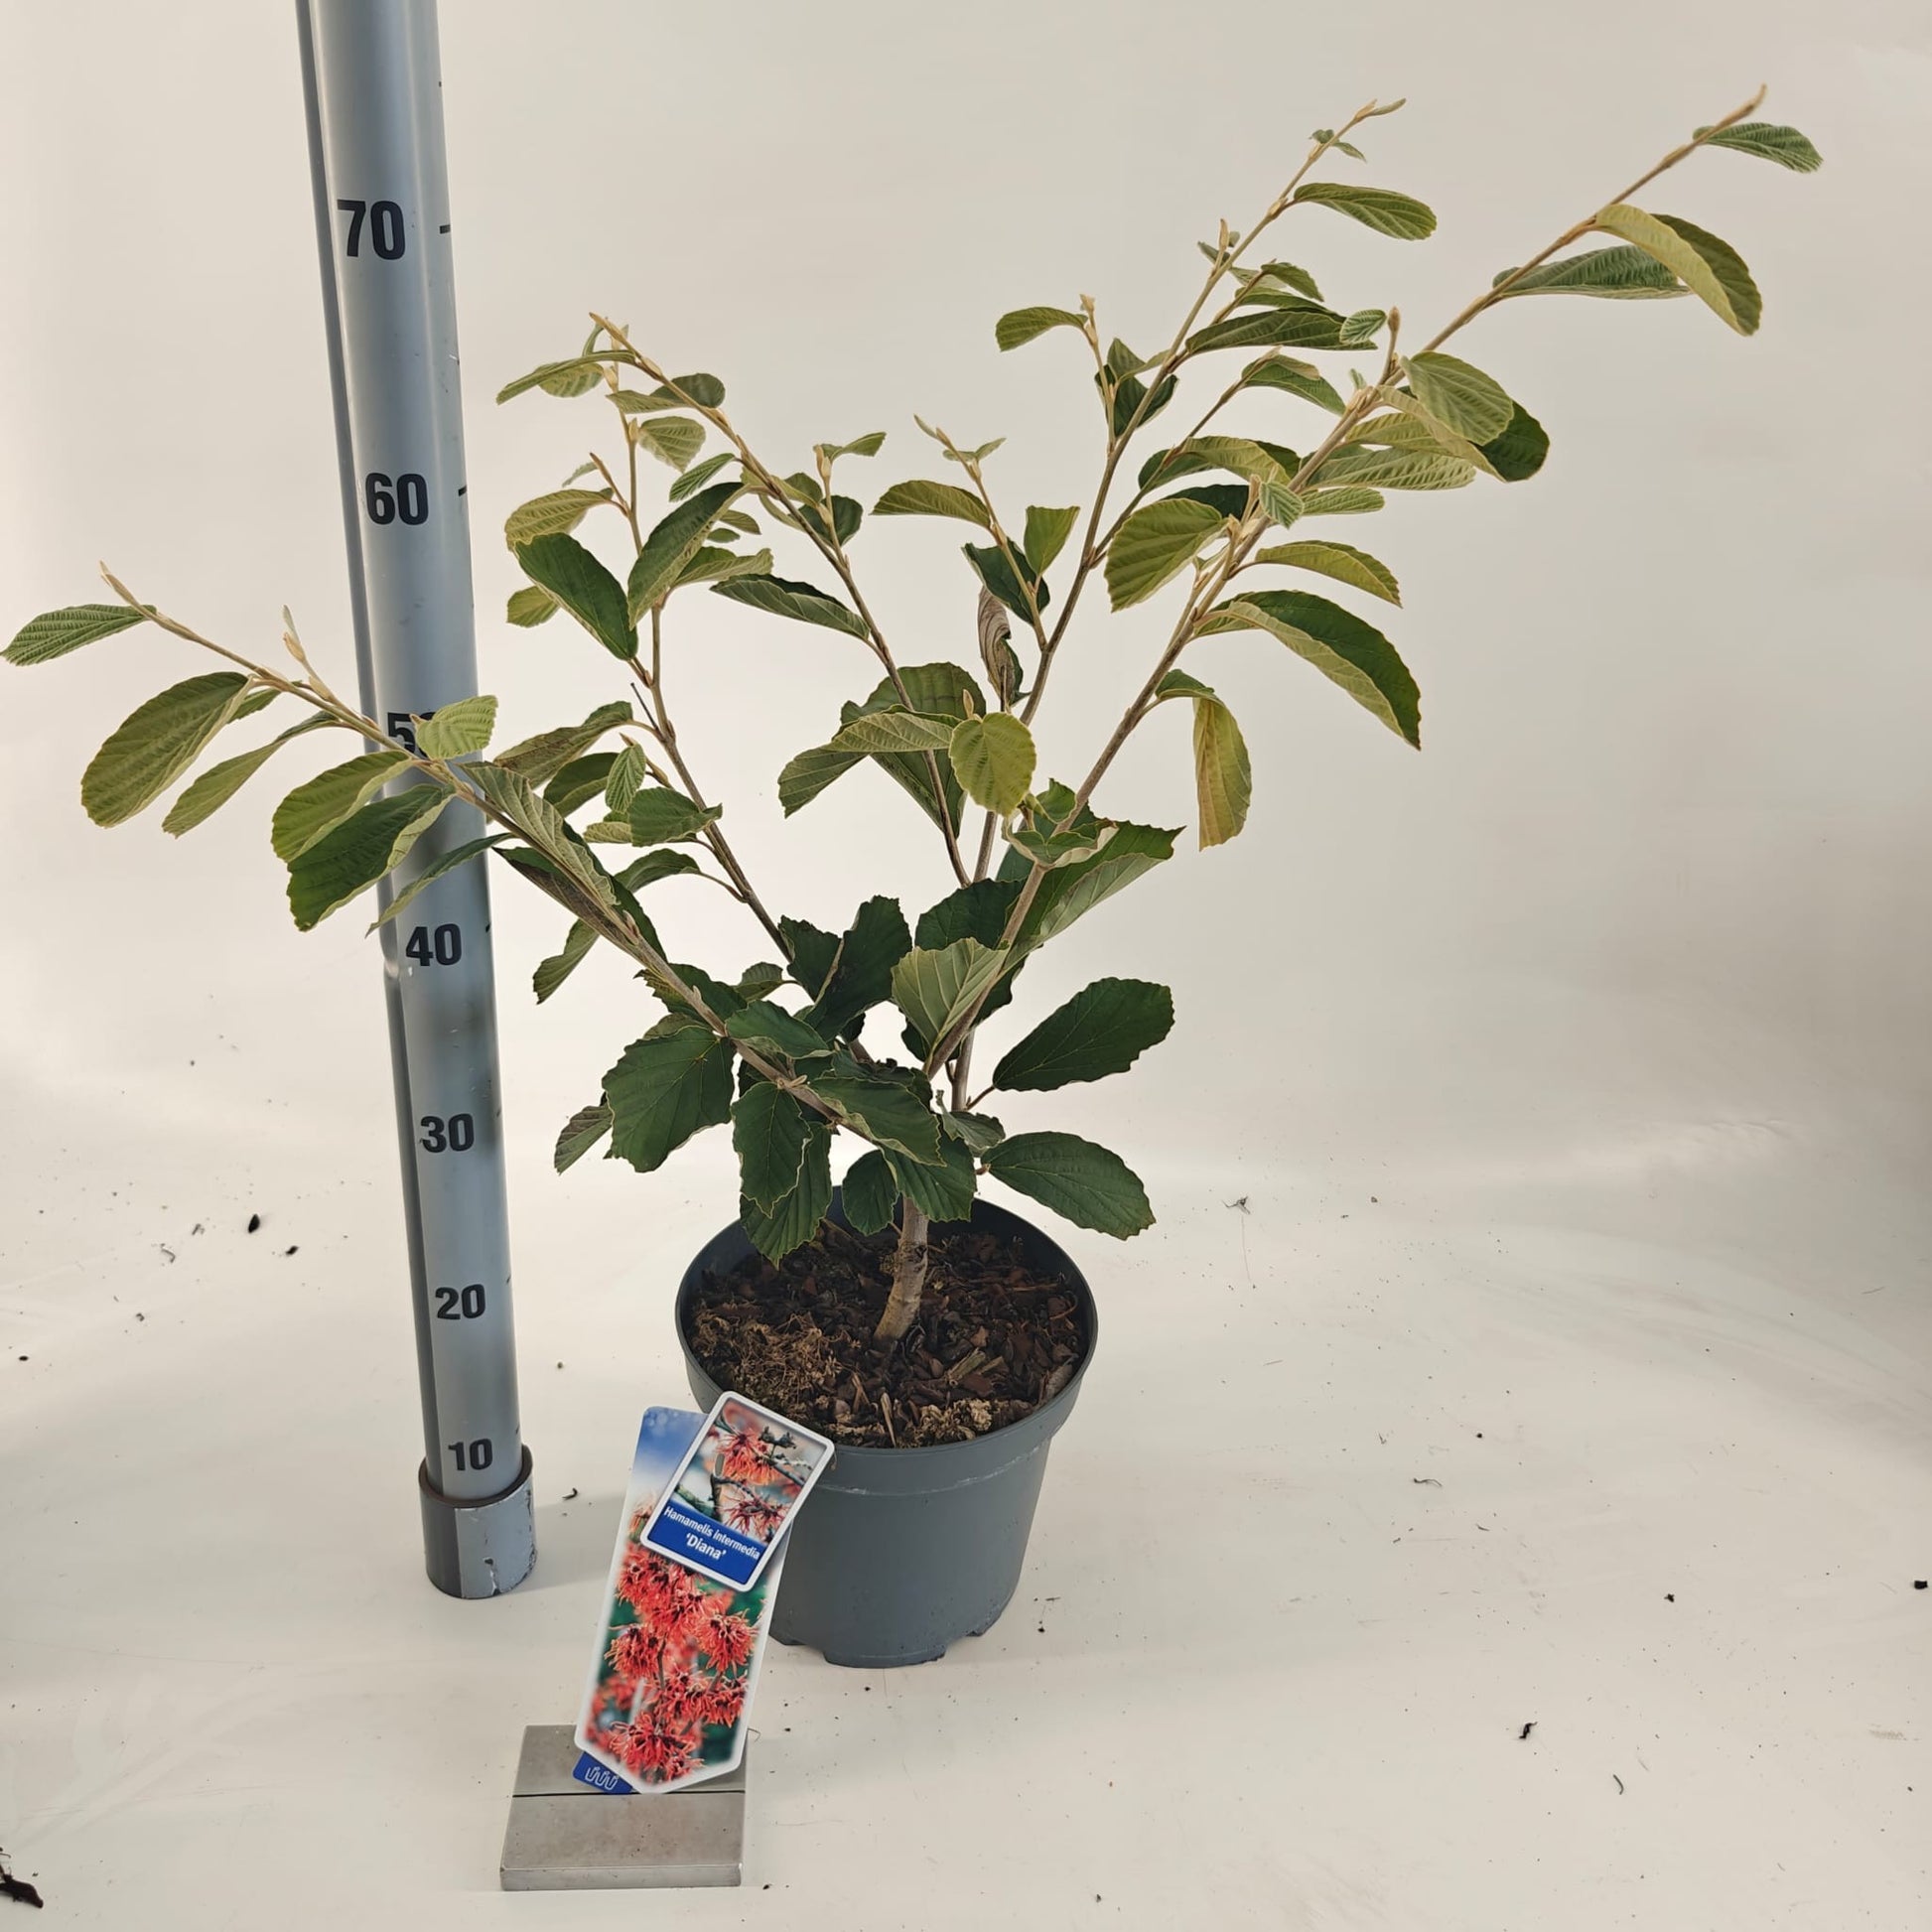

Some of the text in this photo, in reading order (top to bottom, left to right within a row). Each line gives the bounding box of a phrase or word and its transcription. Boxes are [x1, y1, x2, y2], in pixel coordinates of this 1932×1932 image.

[338, 199, 406, 261] 70
[365, 472, 429, 526] 60
[387, 711, 437, 759] 5
[405, 922, 463, 967] 40
[420, 1113, 475, 1154] 30
[435, 1284, 486, 1320] 20
[448, 1438, 493, 1471] 10
[663, 1506, 761, 1561] Hamamelis intermedia
